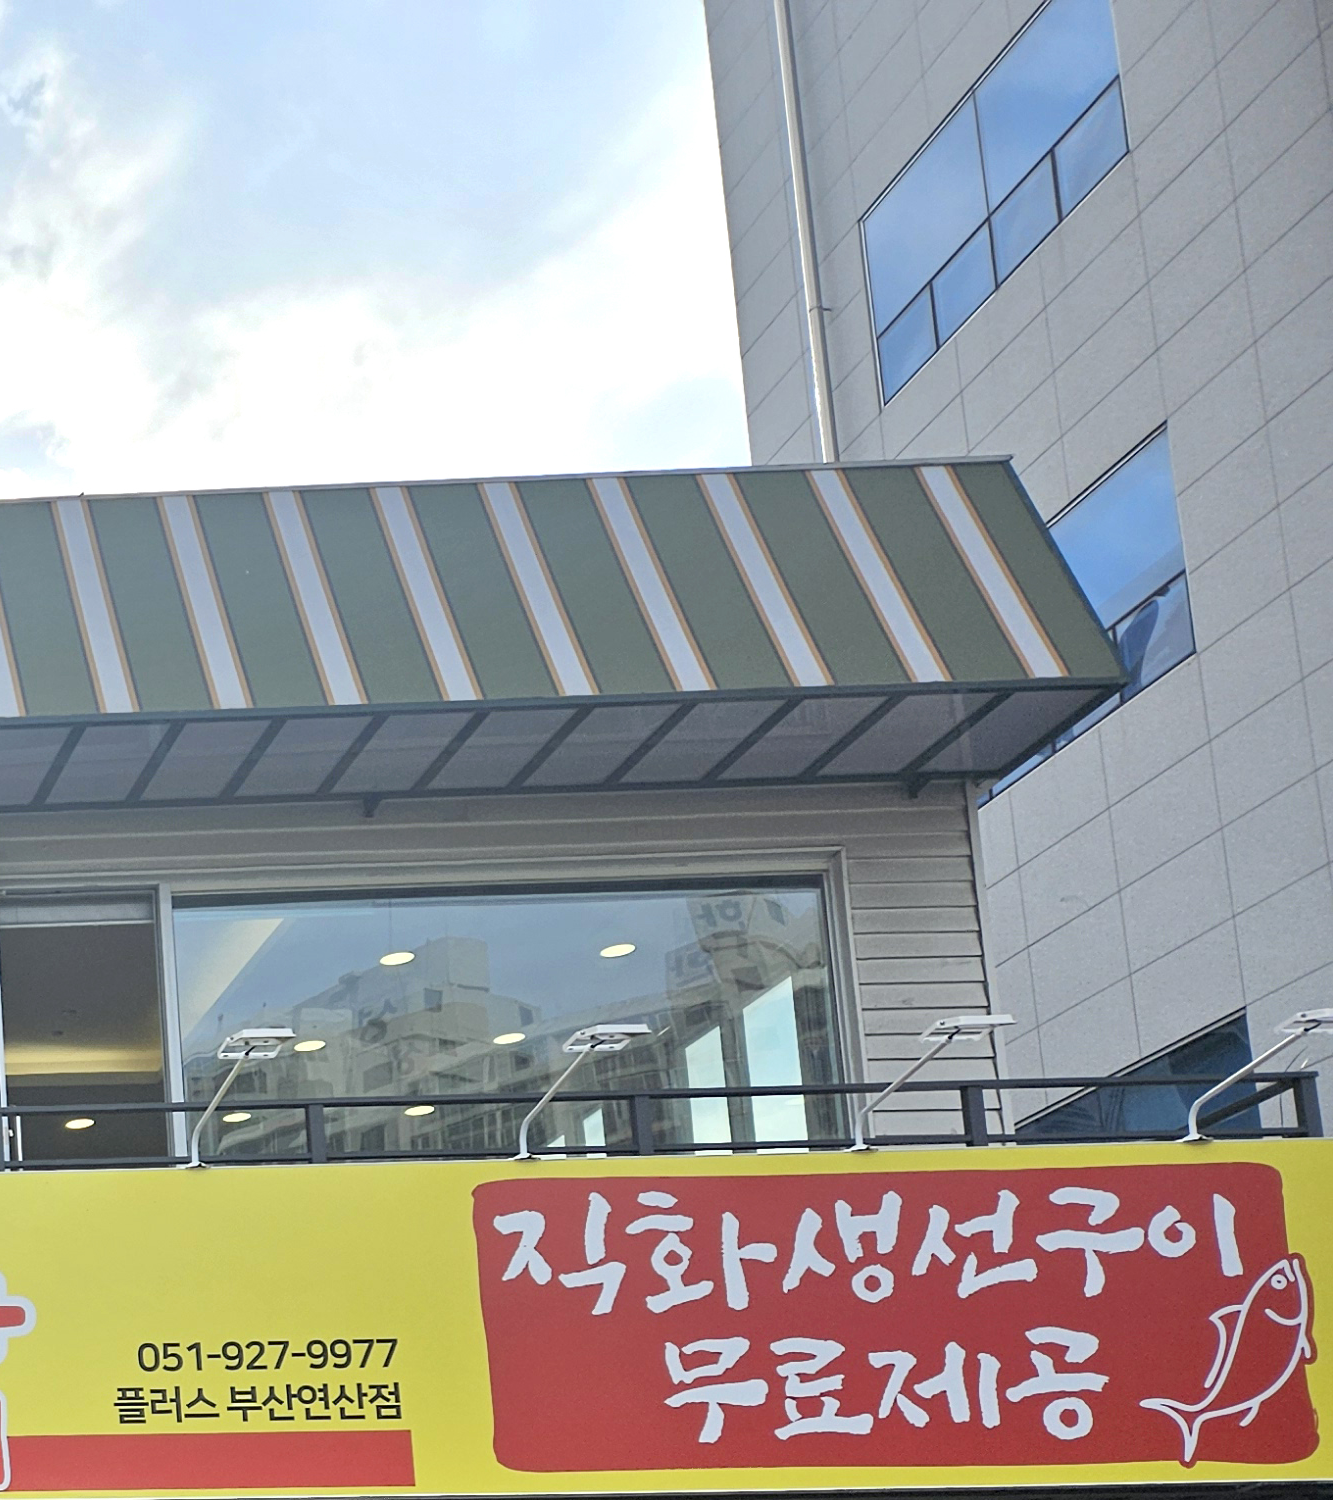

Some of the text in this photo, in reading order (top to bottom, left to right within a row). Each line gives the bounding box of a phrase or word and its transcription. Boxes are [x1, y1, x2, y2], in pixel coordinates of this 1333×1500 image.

[492, 1185, 1245, 1313] 직화생선구이
[137, 1338, 399, 1373] 051-927-9977
[664, 1327, 1109, 1444] 무료제공
[113, 1383, 403, 1425] 플러스 부산연산점
